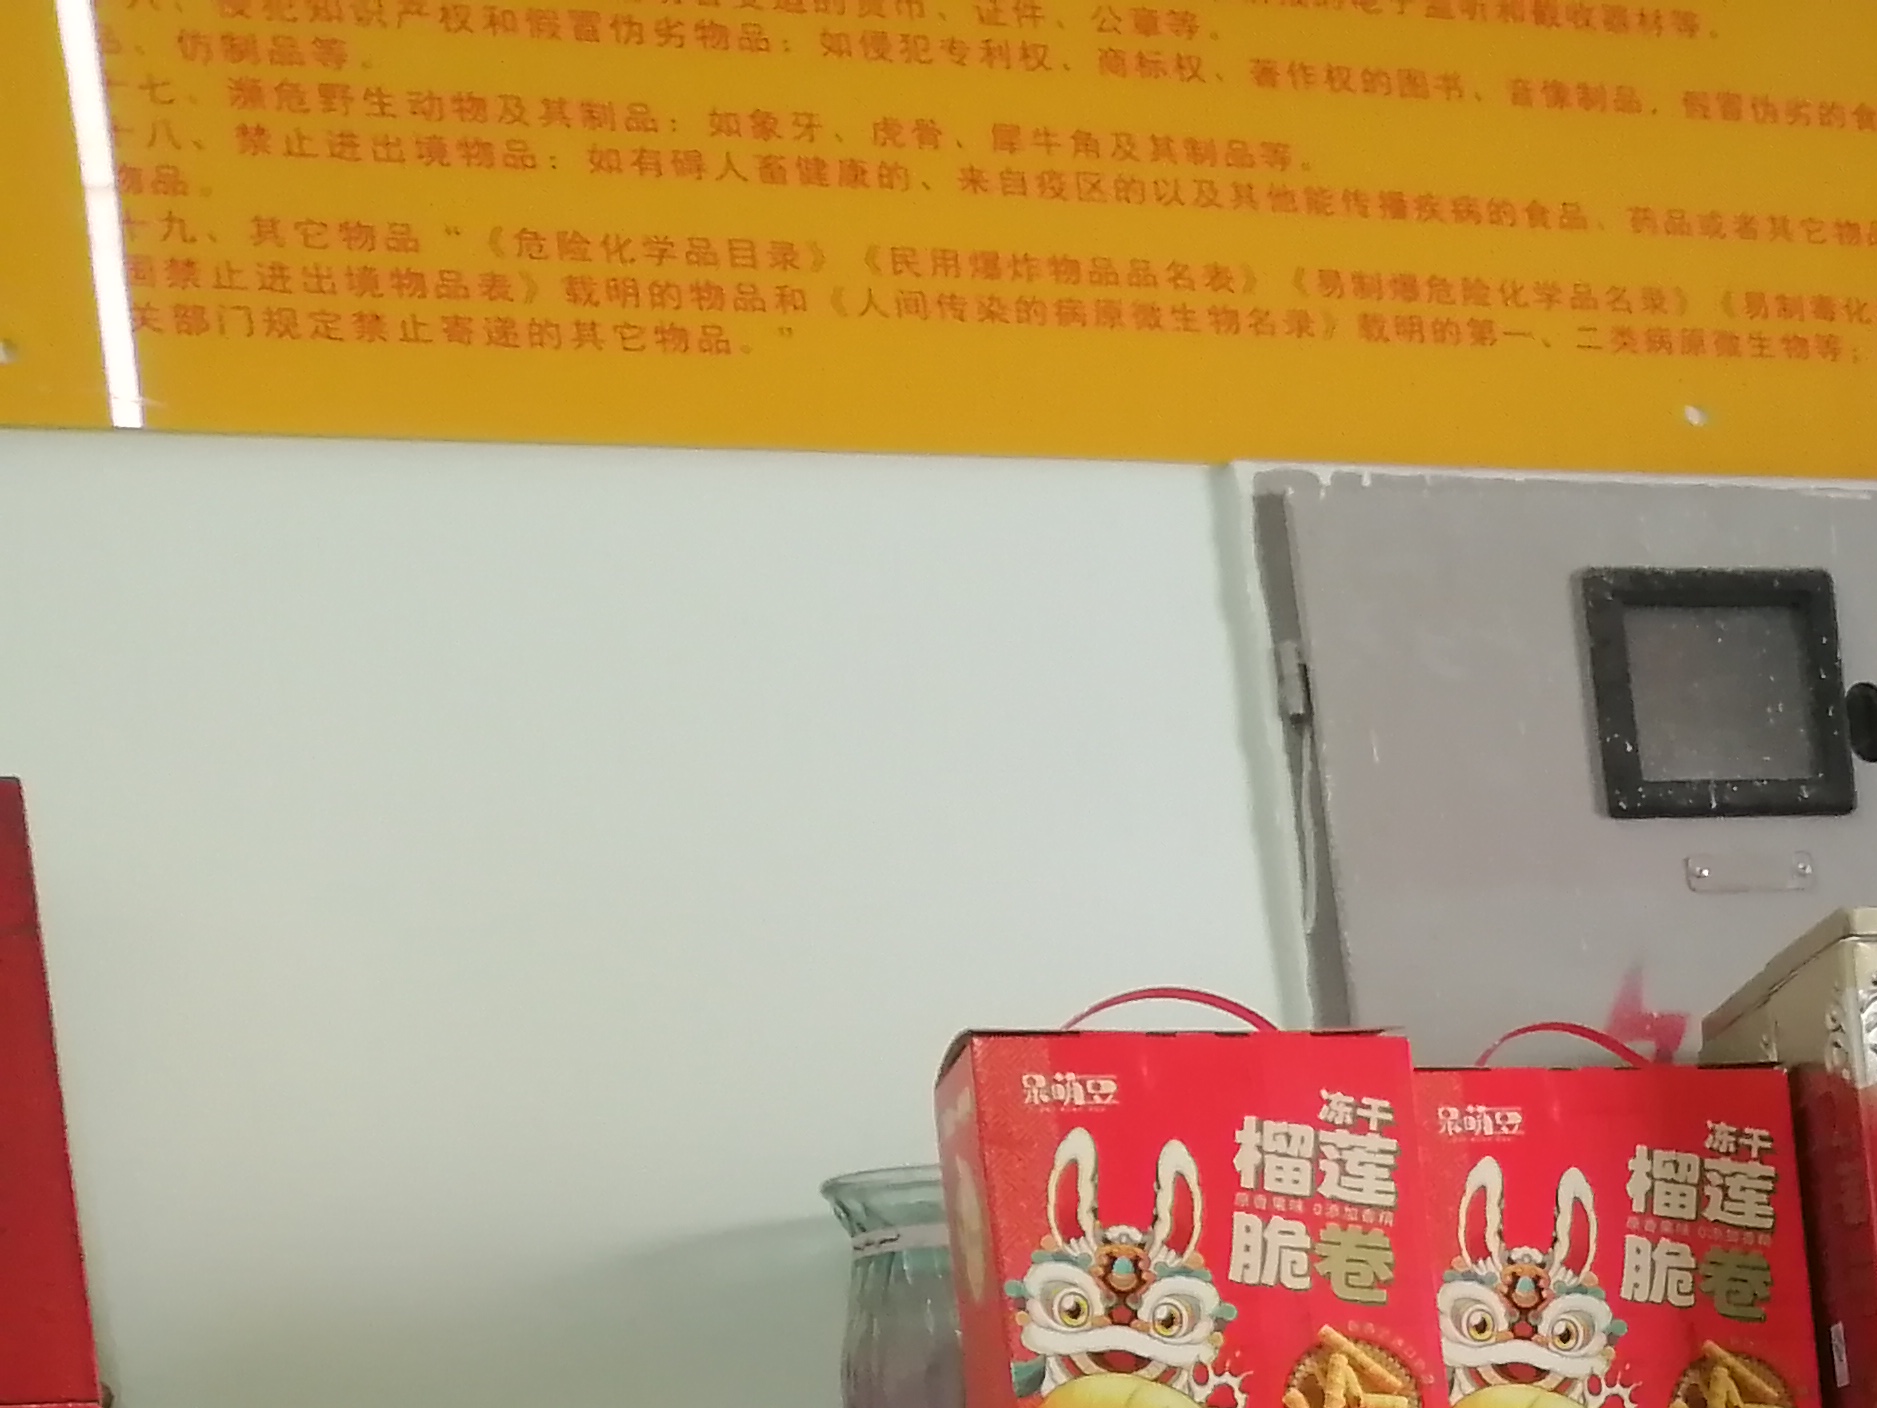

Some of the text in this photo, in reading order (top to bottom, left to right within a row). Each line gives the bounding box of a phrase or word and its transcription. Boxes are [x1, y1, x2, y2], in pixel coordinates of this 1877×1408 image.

[1318, 1088, 1395, 1132] 冻干
[1703, 1119, 1775, 1159] 冻干
[1232, 1114, 1401, 1208] 榴莲
[1626, 1143, 1777, 1230] 榴莲
[1228, 1211, 1396, 1306] 脆卷
[1619, 1233, 1775, 1323] 脆卷
